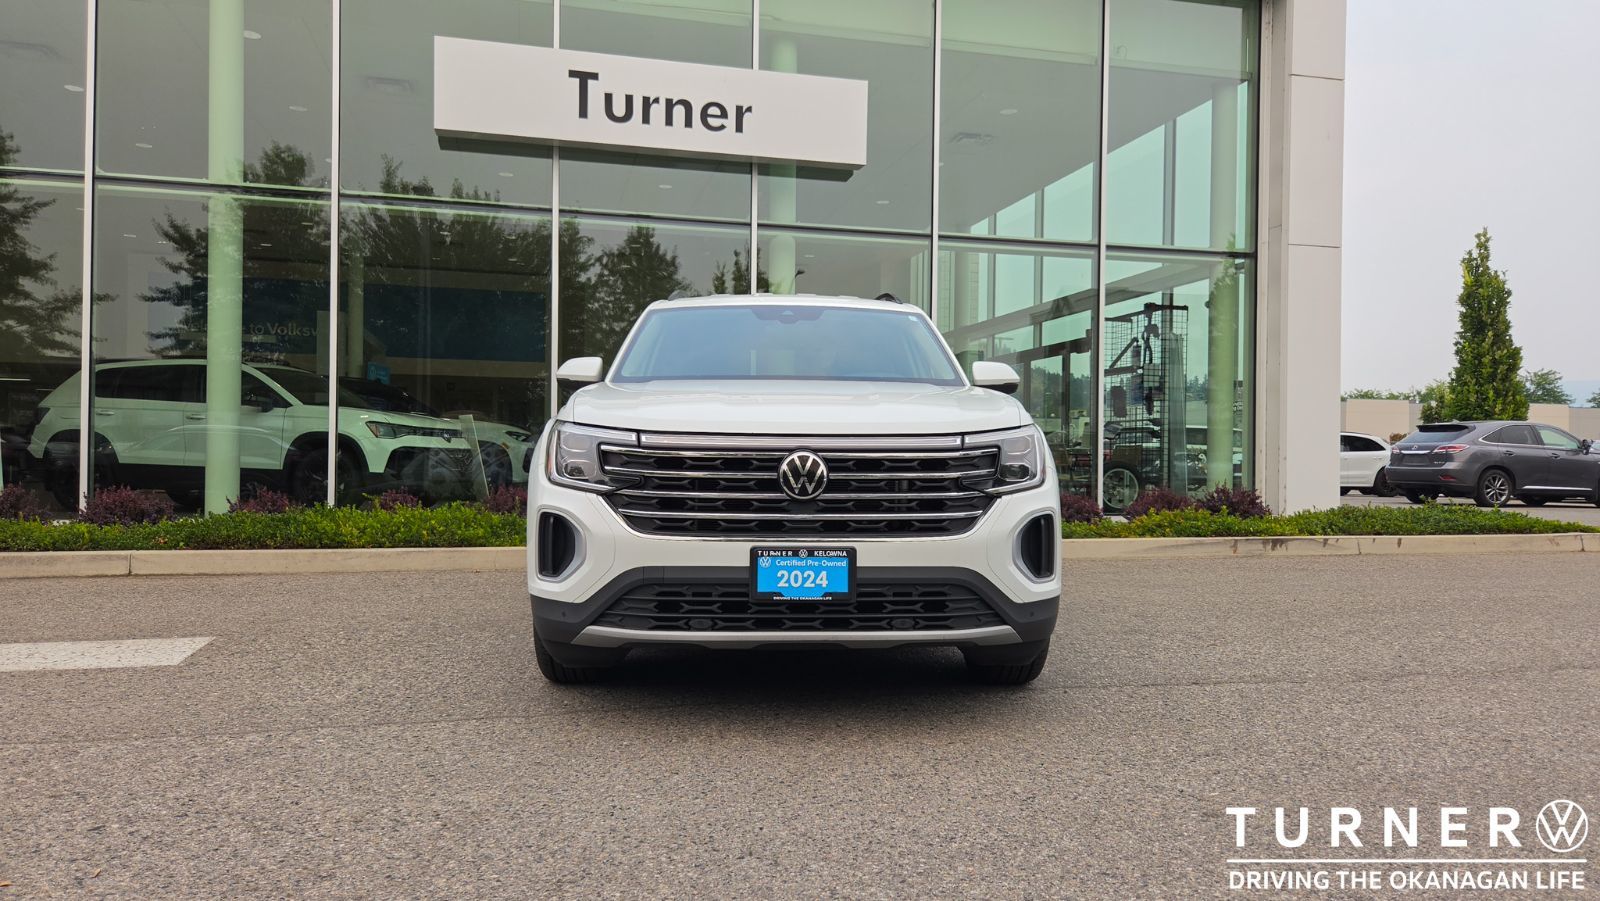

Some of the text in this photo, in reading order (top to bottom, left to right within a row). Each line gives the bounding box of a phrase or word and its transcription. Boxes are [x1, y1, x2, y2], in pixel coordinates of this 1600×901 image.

[568, 69, 753, 133] Turner
[249, 322, 265, 335] to
[775, 559, 805, 567] Certified
[807, 559, 847, 567] Pre-Owned
[776, 570, 828, 588] 2024
